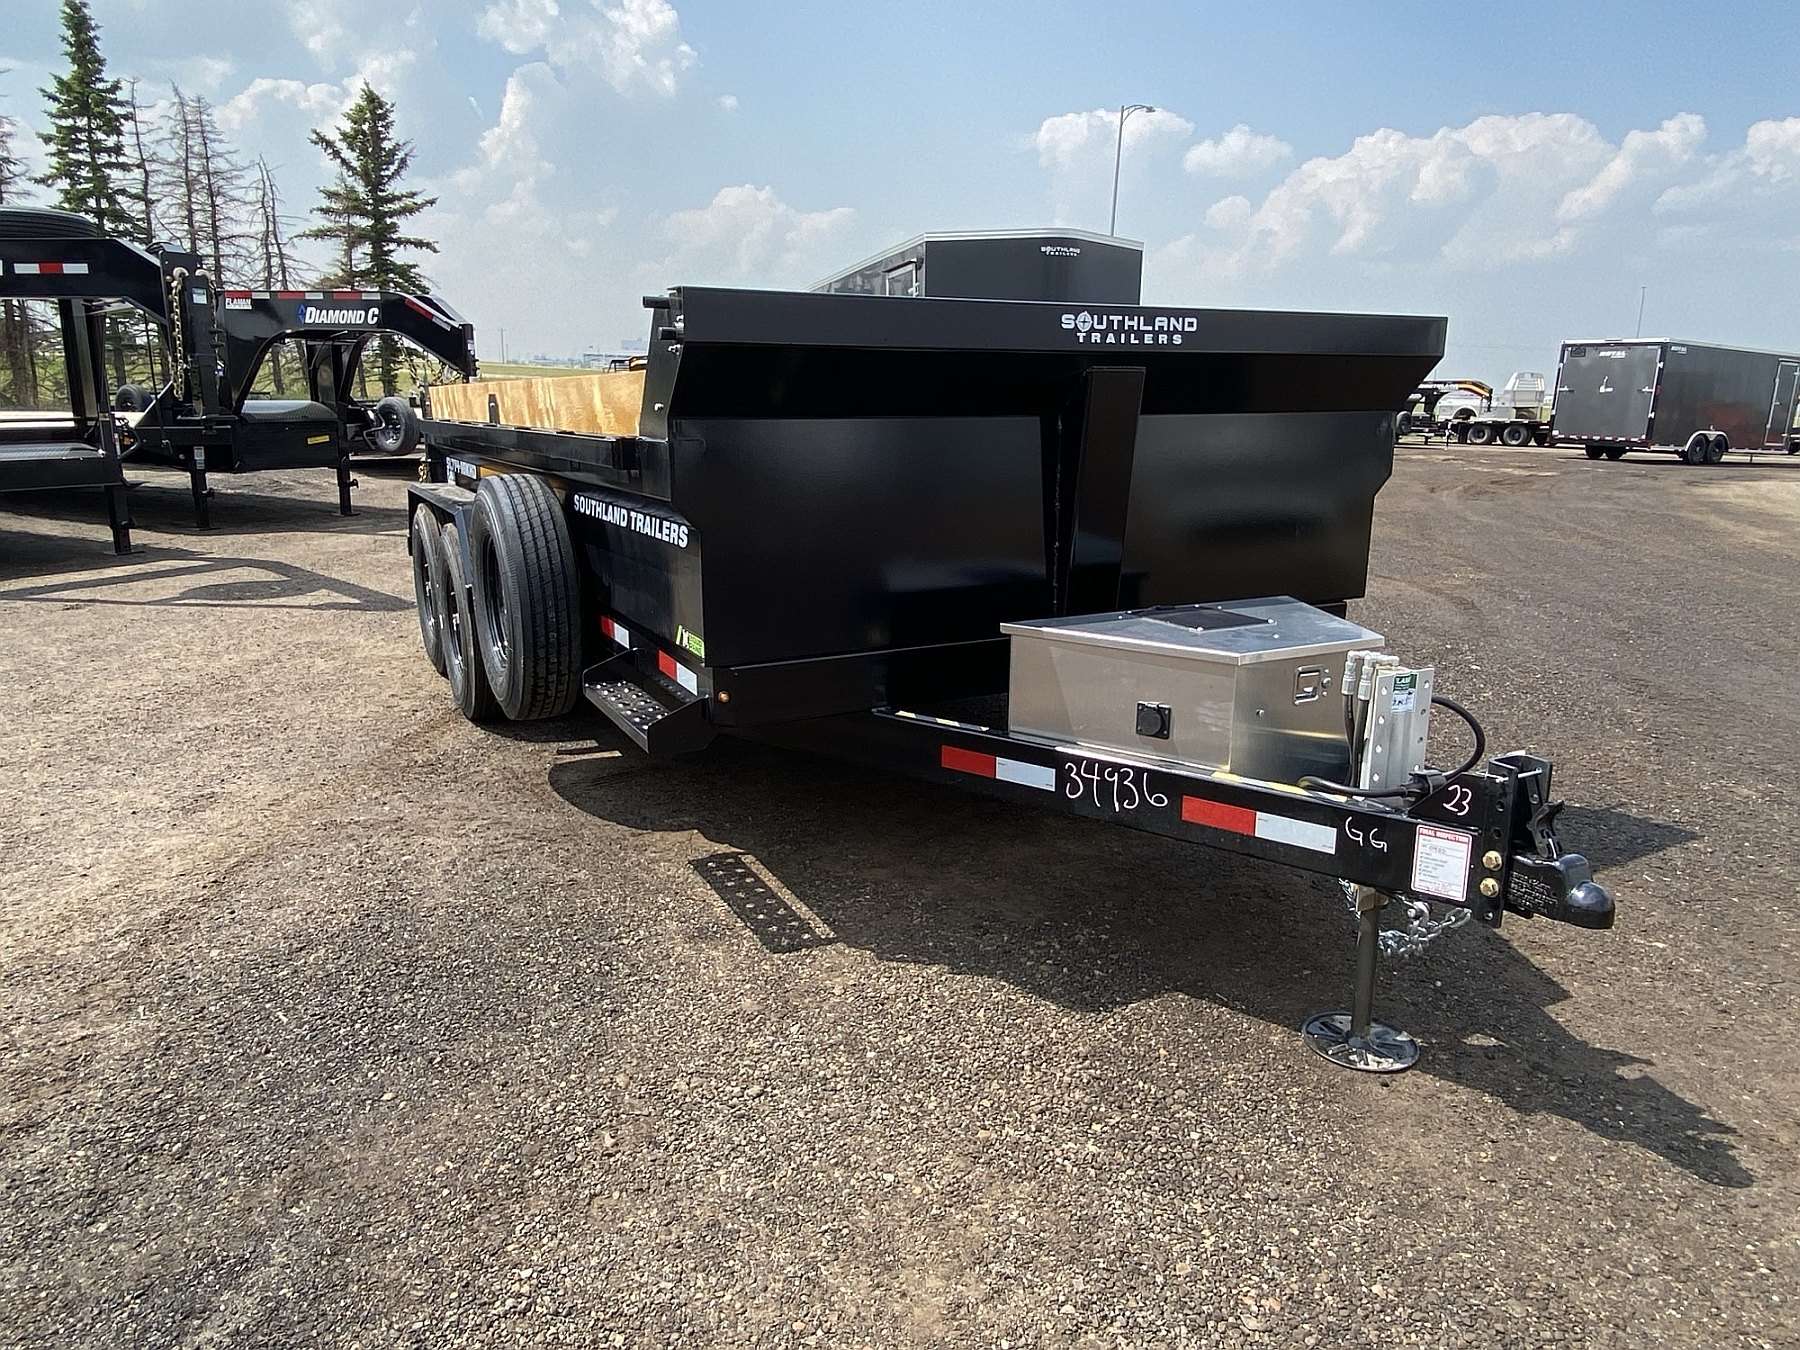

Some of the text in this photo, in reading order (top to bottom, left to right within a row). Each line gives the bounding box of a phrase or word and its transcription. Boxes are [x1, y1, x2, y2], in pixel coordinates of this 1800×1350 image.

[305, 307, 379, 324] DIAMOND C
[1061, 311, 1198, 333] SOUTHLAND
[1076, 332, 1183, 345] TRAILERS
[573, 494, 689, 548] SOUTHLAND TRAILERS
[1064, 760, 1168, 812] 34936
[1444, 785, 1472, 815] 23
